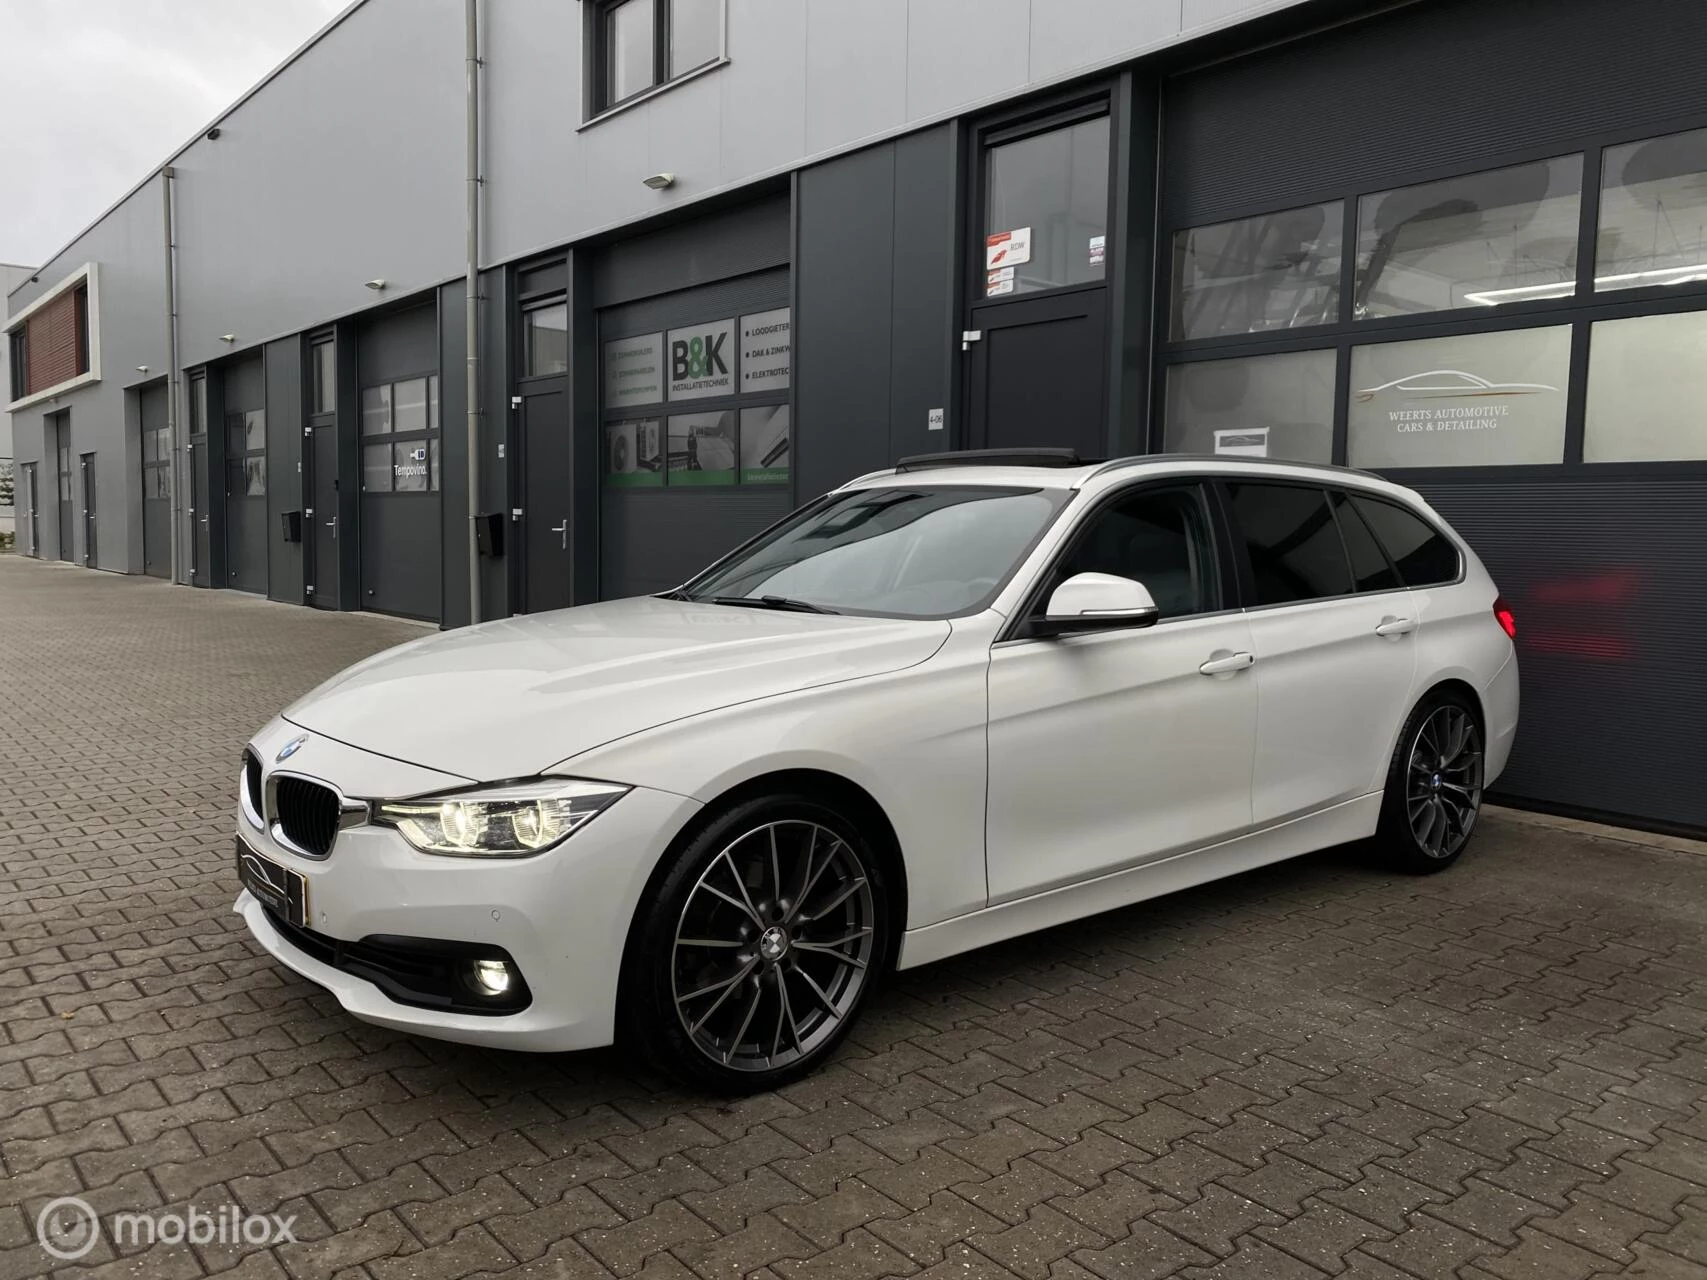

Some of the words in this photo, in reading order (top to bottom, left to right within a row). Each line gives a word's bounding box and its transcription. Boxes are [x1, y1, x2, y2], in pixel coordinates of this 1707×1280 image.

[672, 332, 729, 381] B&K
[751, 350, 765, 359] DAK
[672, 378, 729, 391] INSTALLATIETECHNIEK
[1389, 409, 1432, 421] WEERTS
[1434, 405, 1509, 419] AUTOMOTIVE
[1397, 422, 1424, 433] CARS
[1426, 421, 1434, 431] &
[1437, 418, 1497, 431] DETAILING
